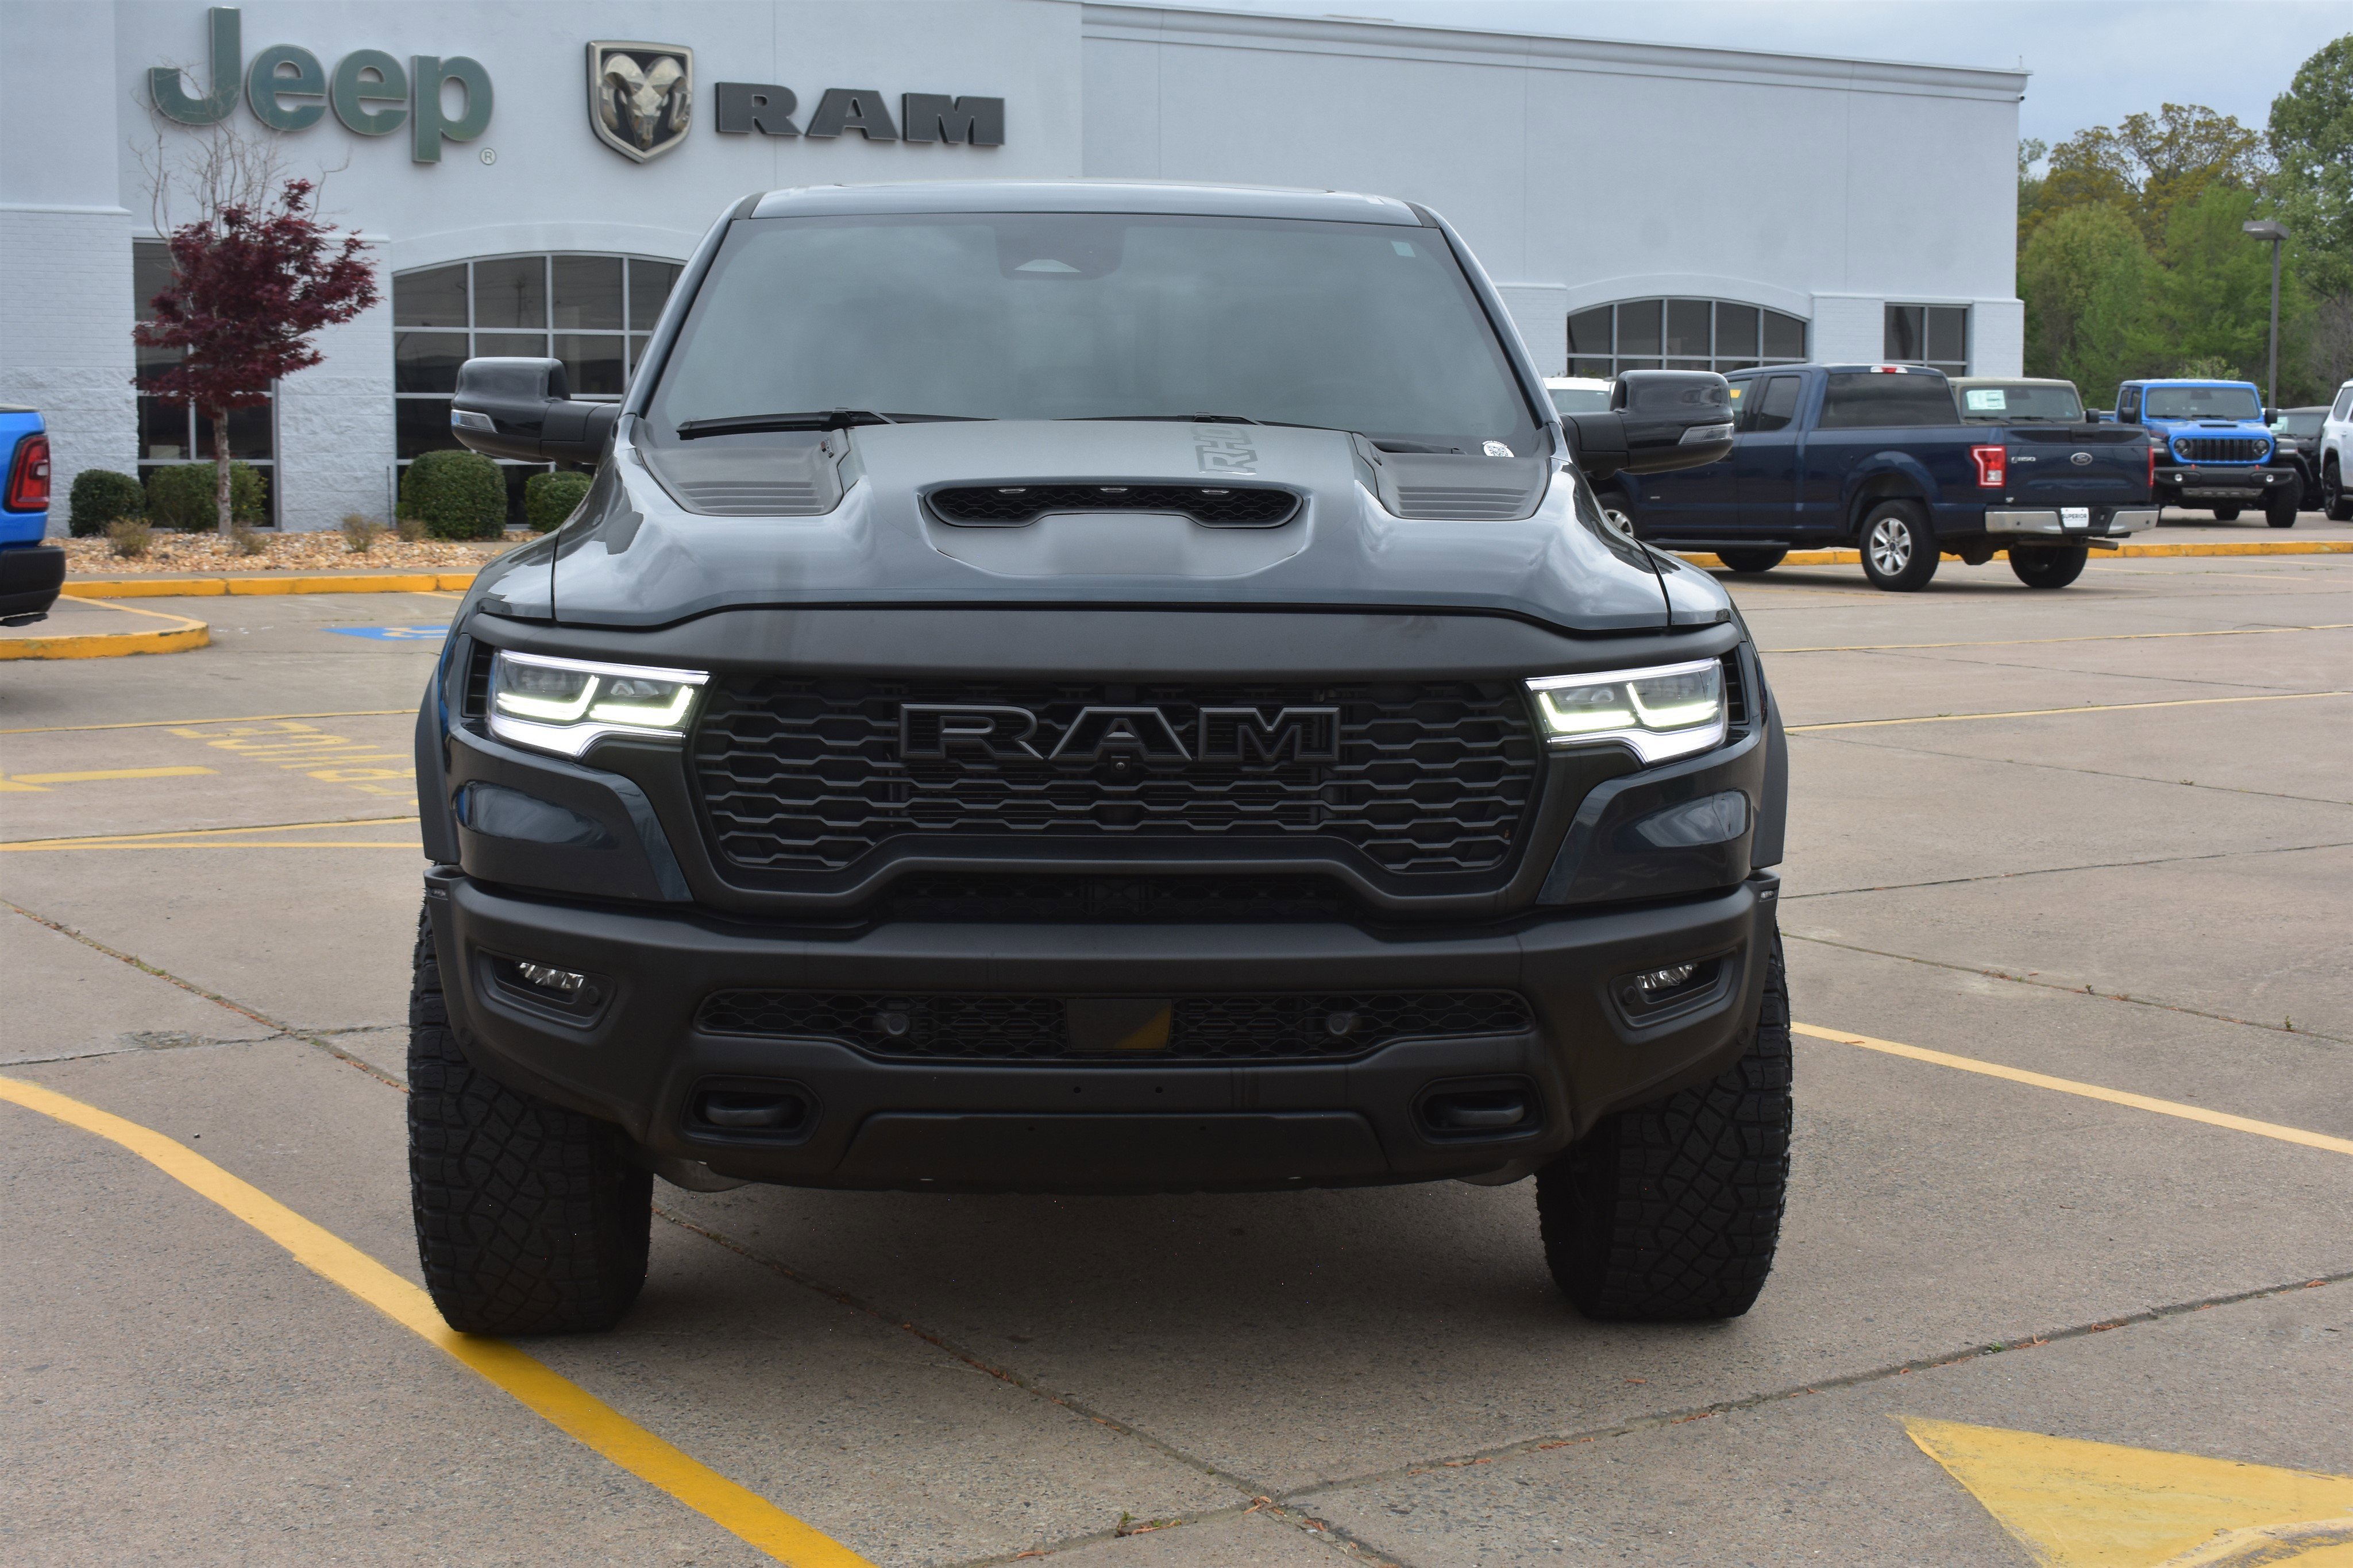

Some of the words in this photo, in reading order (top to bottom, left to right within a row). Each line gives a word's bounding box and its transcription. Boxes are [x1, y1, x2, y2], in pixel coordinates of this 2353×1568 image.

[148, 6, 494, 163] Jeep
[715, 81, 1005, 145] RAM
[1190, 424, 1259, 476] RHO
[167, 722, 419, 805] RVICE
[899, 701, 1342, 762] RAM
